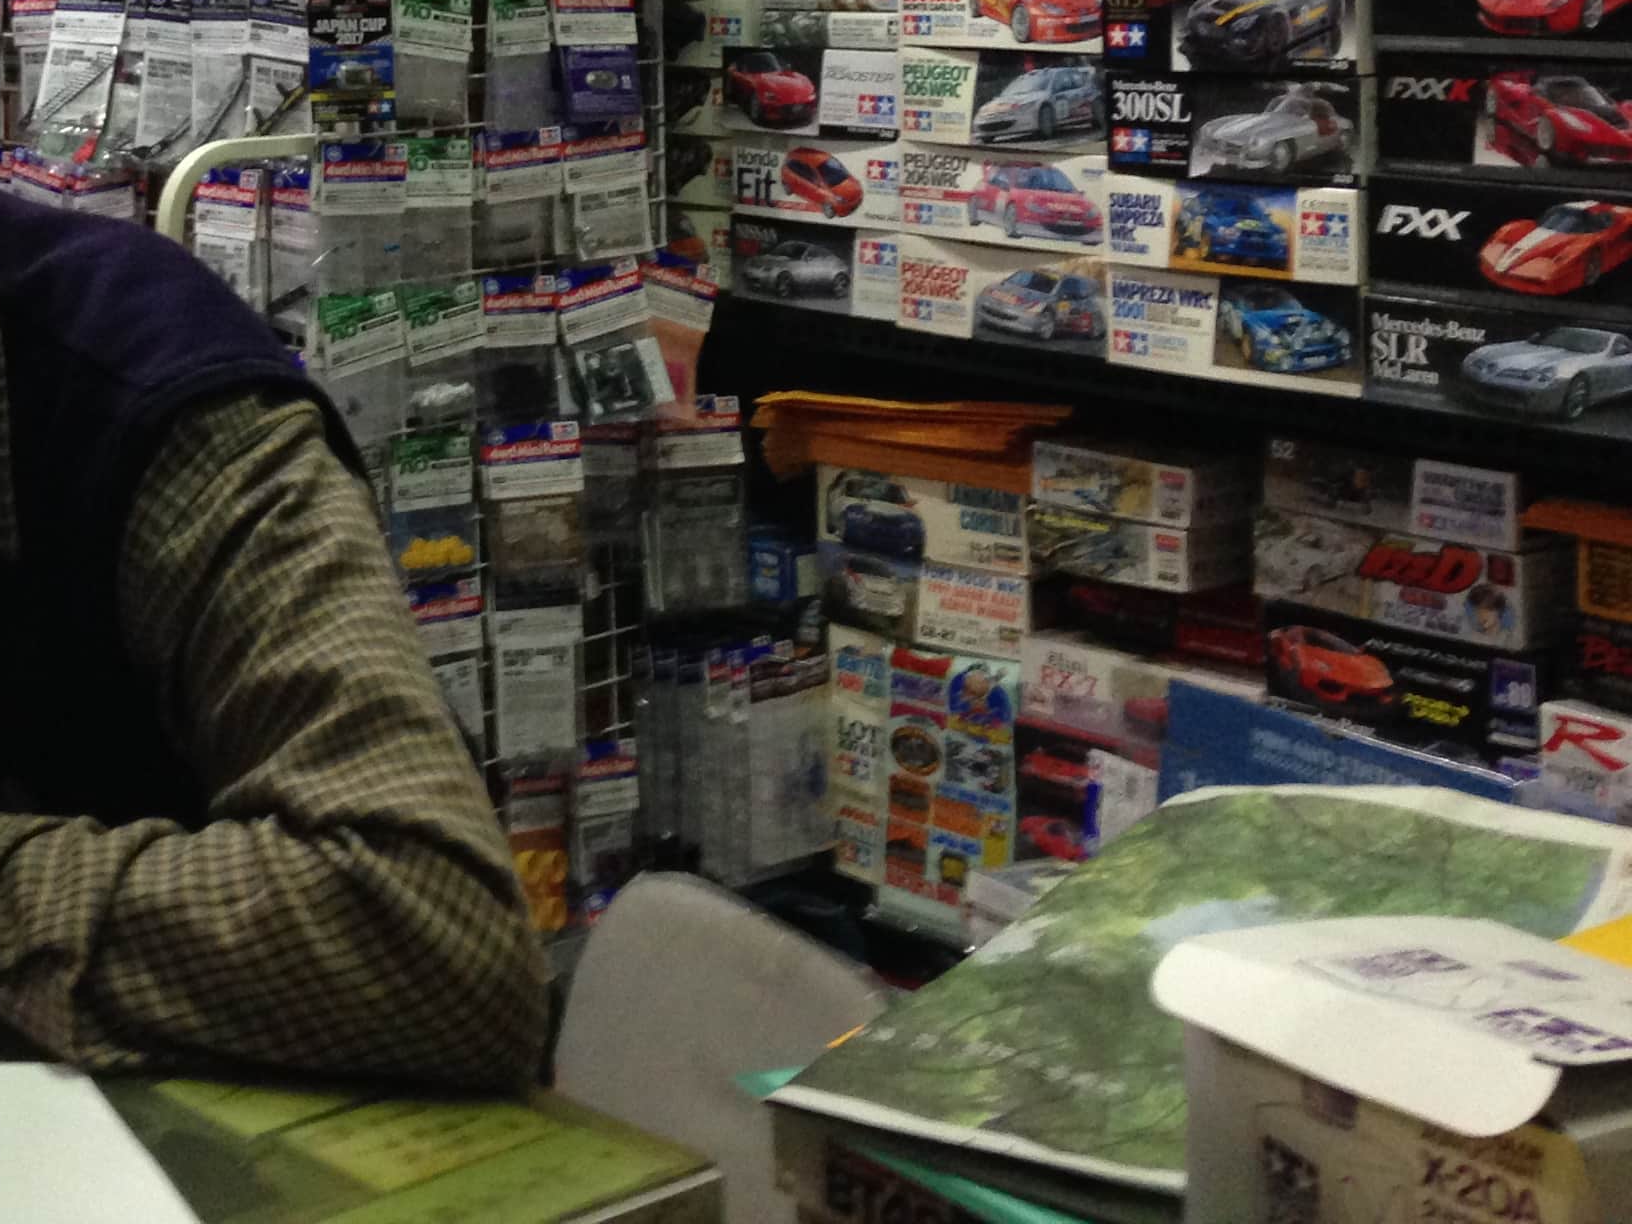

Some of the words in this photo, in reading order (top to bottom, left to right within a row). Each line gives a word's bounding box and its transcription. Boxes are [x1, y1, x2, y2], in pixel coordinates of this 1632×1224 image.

[315, 18, 356, 33] JAPAN
[359, 17, 386, 32] CUP
[336, 31, 364, 45] 2017
[902, 64, 972, 82] PEUGEOT
[931, 82, 961, 97] WRC
[1113, 80, 1177, 93] Mercedes-Benz
[1111, 91, 1191, 123] 300SL
[737, 146, 779, 167] Honda
[902, 152, 971, 171] PEUGEOT
[931, 171, 960, 189] WRC
[1109, 192, 1161, 210] SUBARU
[1110, 208, 1165, 227] IMPREZA
[1376, 204, 1472, 241] FXX
[901, 261, 968, 280] PEUGEOT
[1112, 279, 1177, 304] IMPREZA
[1179, 289, 1214, 310] WRC
[1372, 312, 1485, 343] Mercedes-Benz
[1372, 330, 1429, 365] SLR
[1271, 440, 1294, 459] 52
